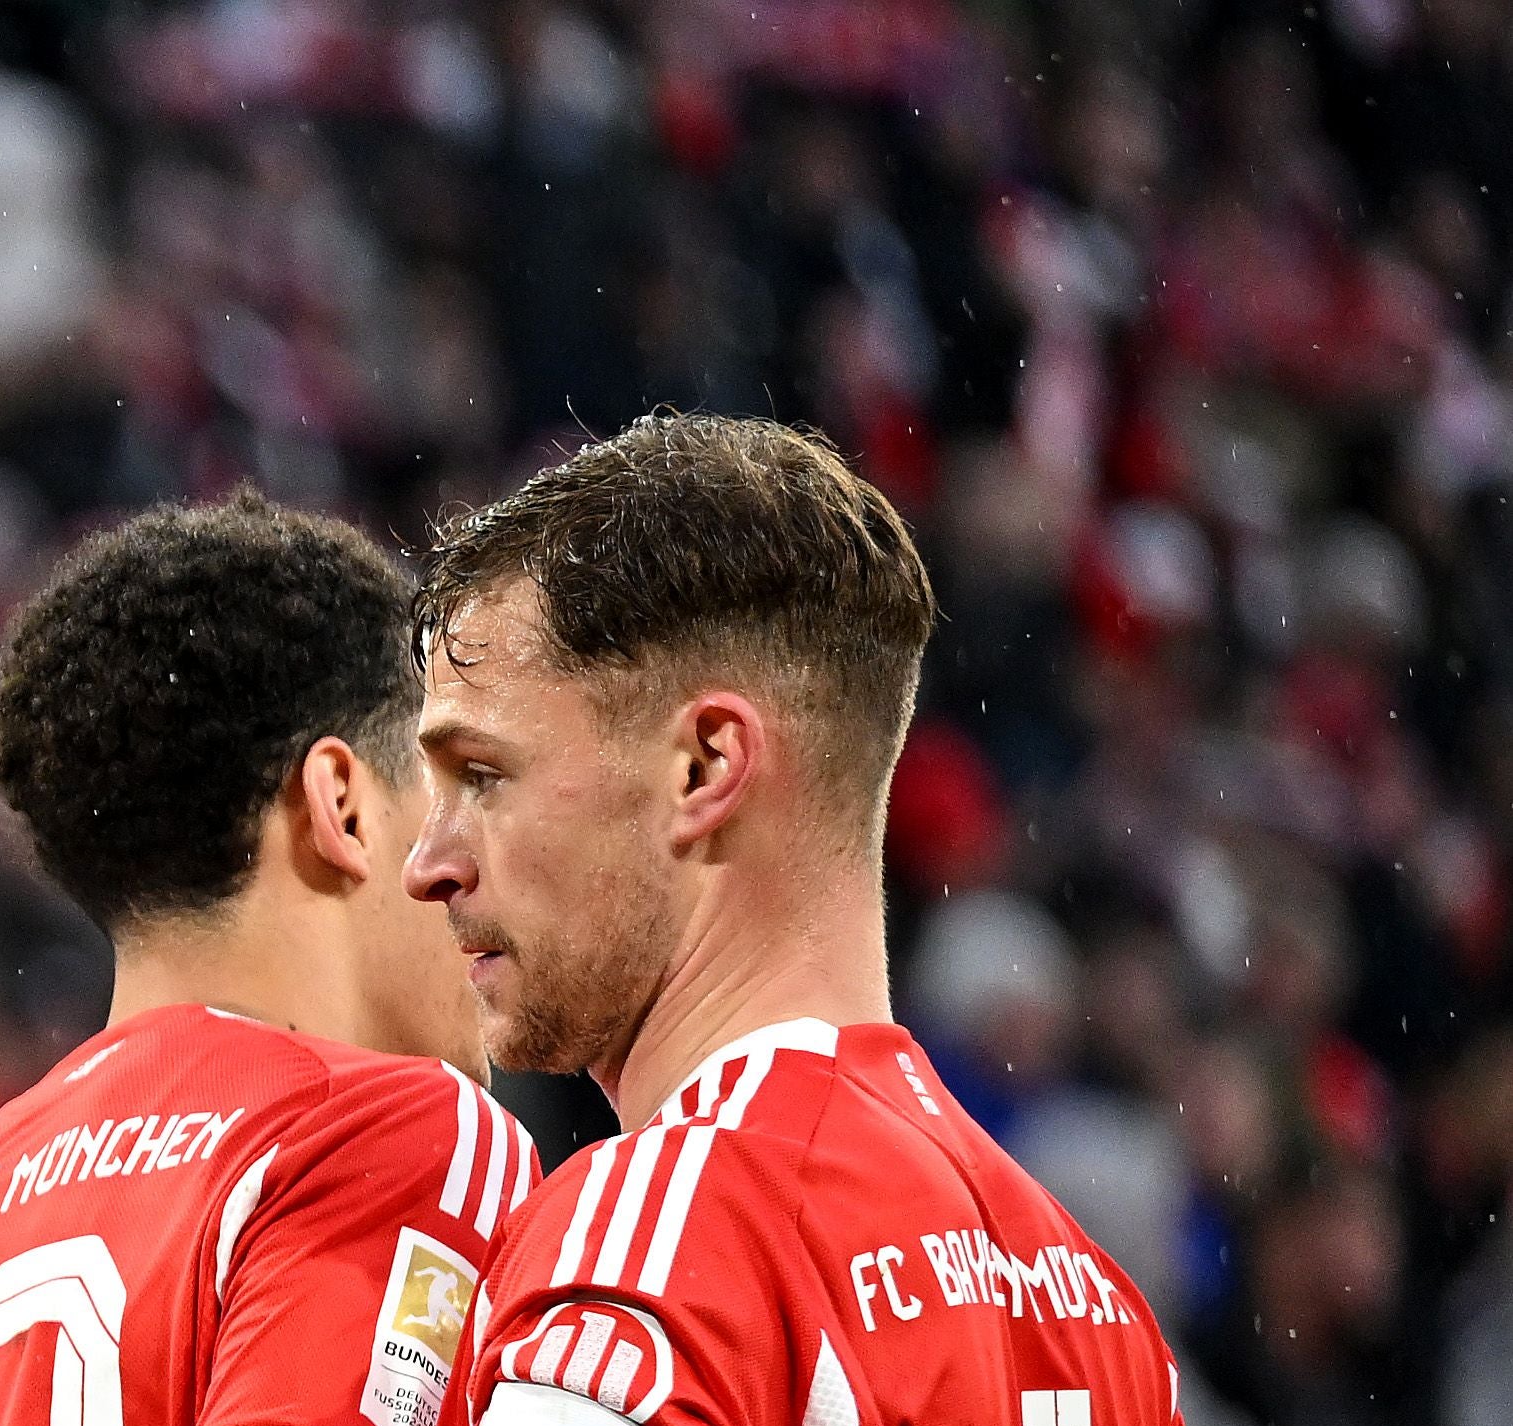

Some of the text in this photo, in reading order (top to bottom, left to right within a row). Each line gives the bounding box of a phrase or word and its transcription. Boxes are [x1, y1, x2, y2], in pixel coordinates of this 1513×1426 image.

[0, 1107, 245, 1214] MÜNCHEN
[850, 1245, 922, 1332] FC
[384, 1341, 450, 1391] BUNDES
